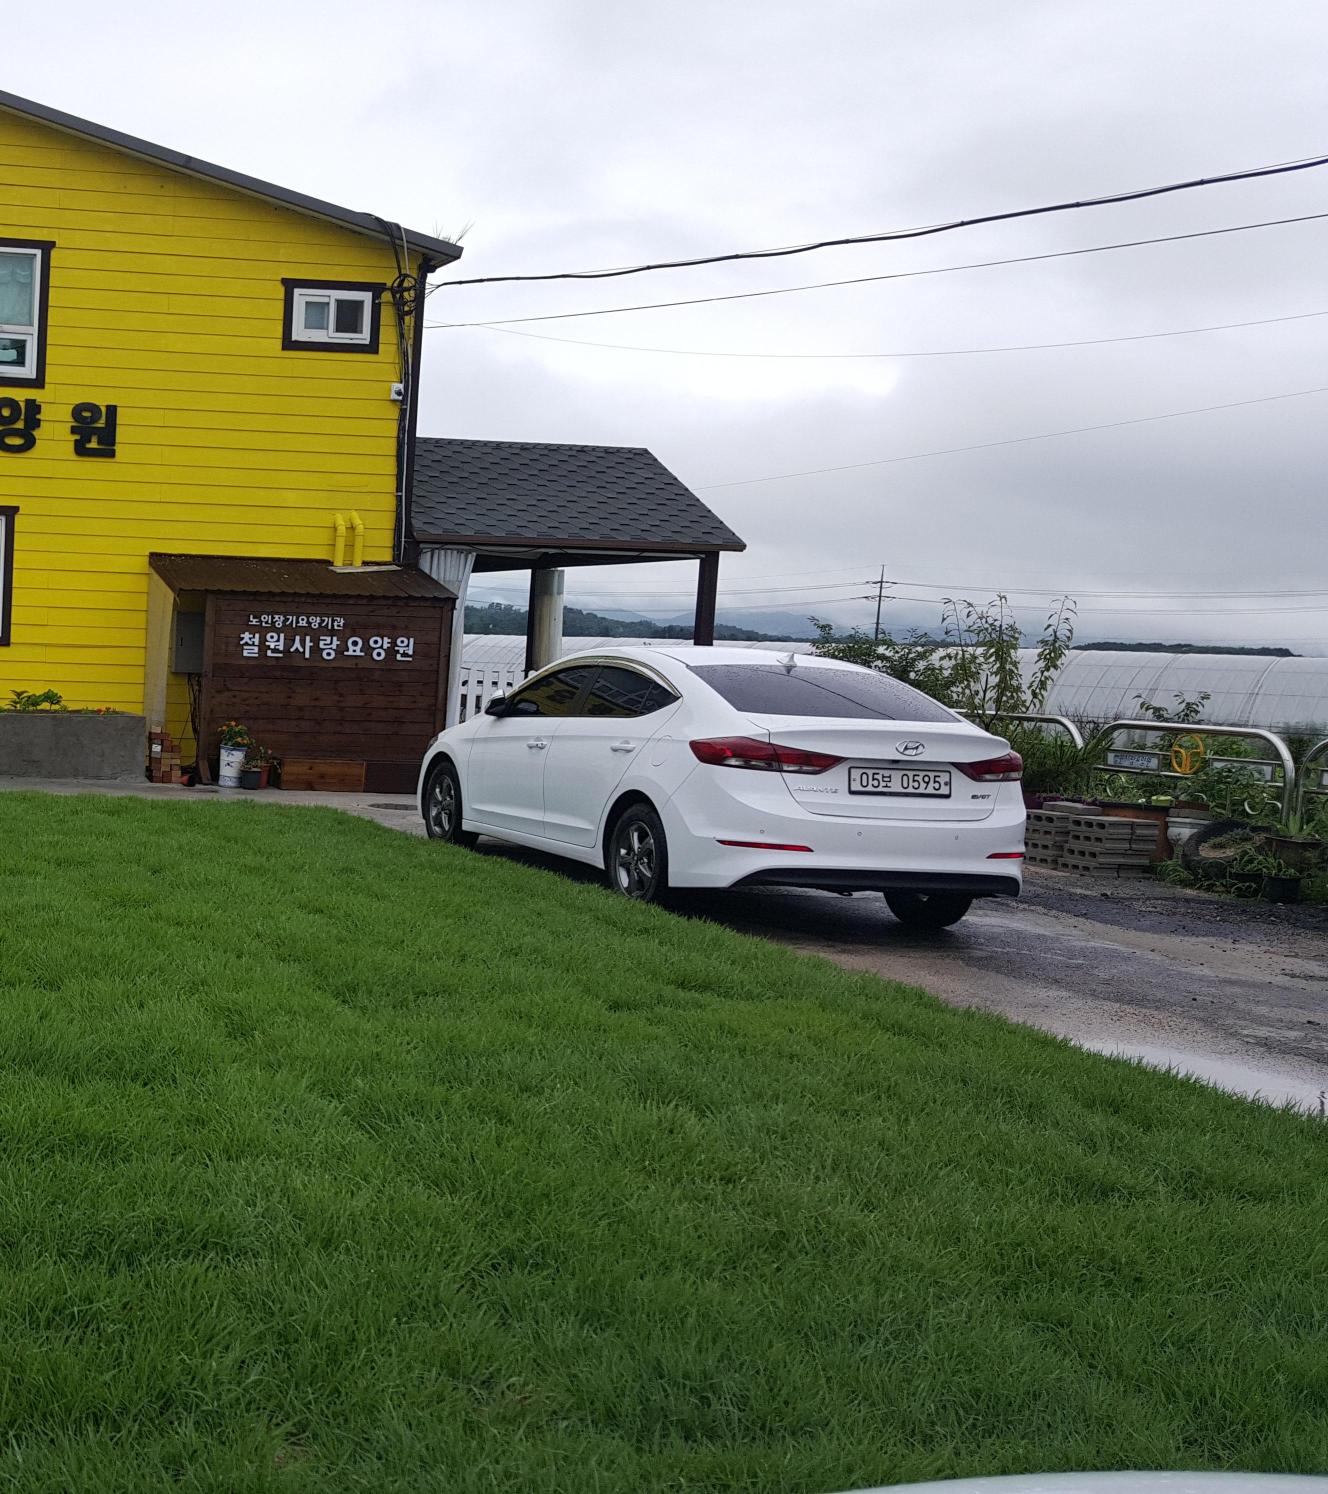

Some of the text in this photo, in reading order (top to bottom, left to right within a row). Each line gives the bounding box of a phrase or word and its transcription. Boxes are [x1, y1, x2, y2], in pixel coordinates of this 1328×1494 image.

[248, 614, 345, 630] 노인장기요양기관
[239, 631, 415, 662] 철원사랑요양원
[859, 771, 942, 791] 05보 0595
